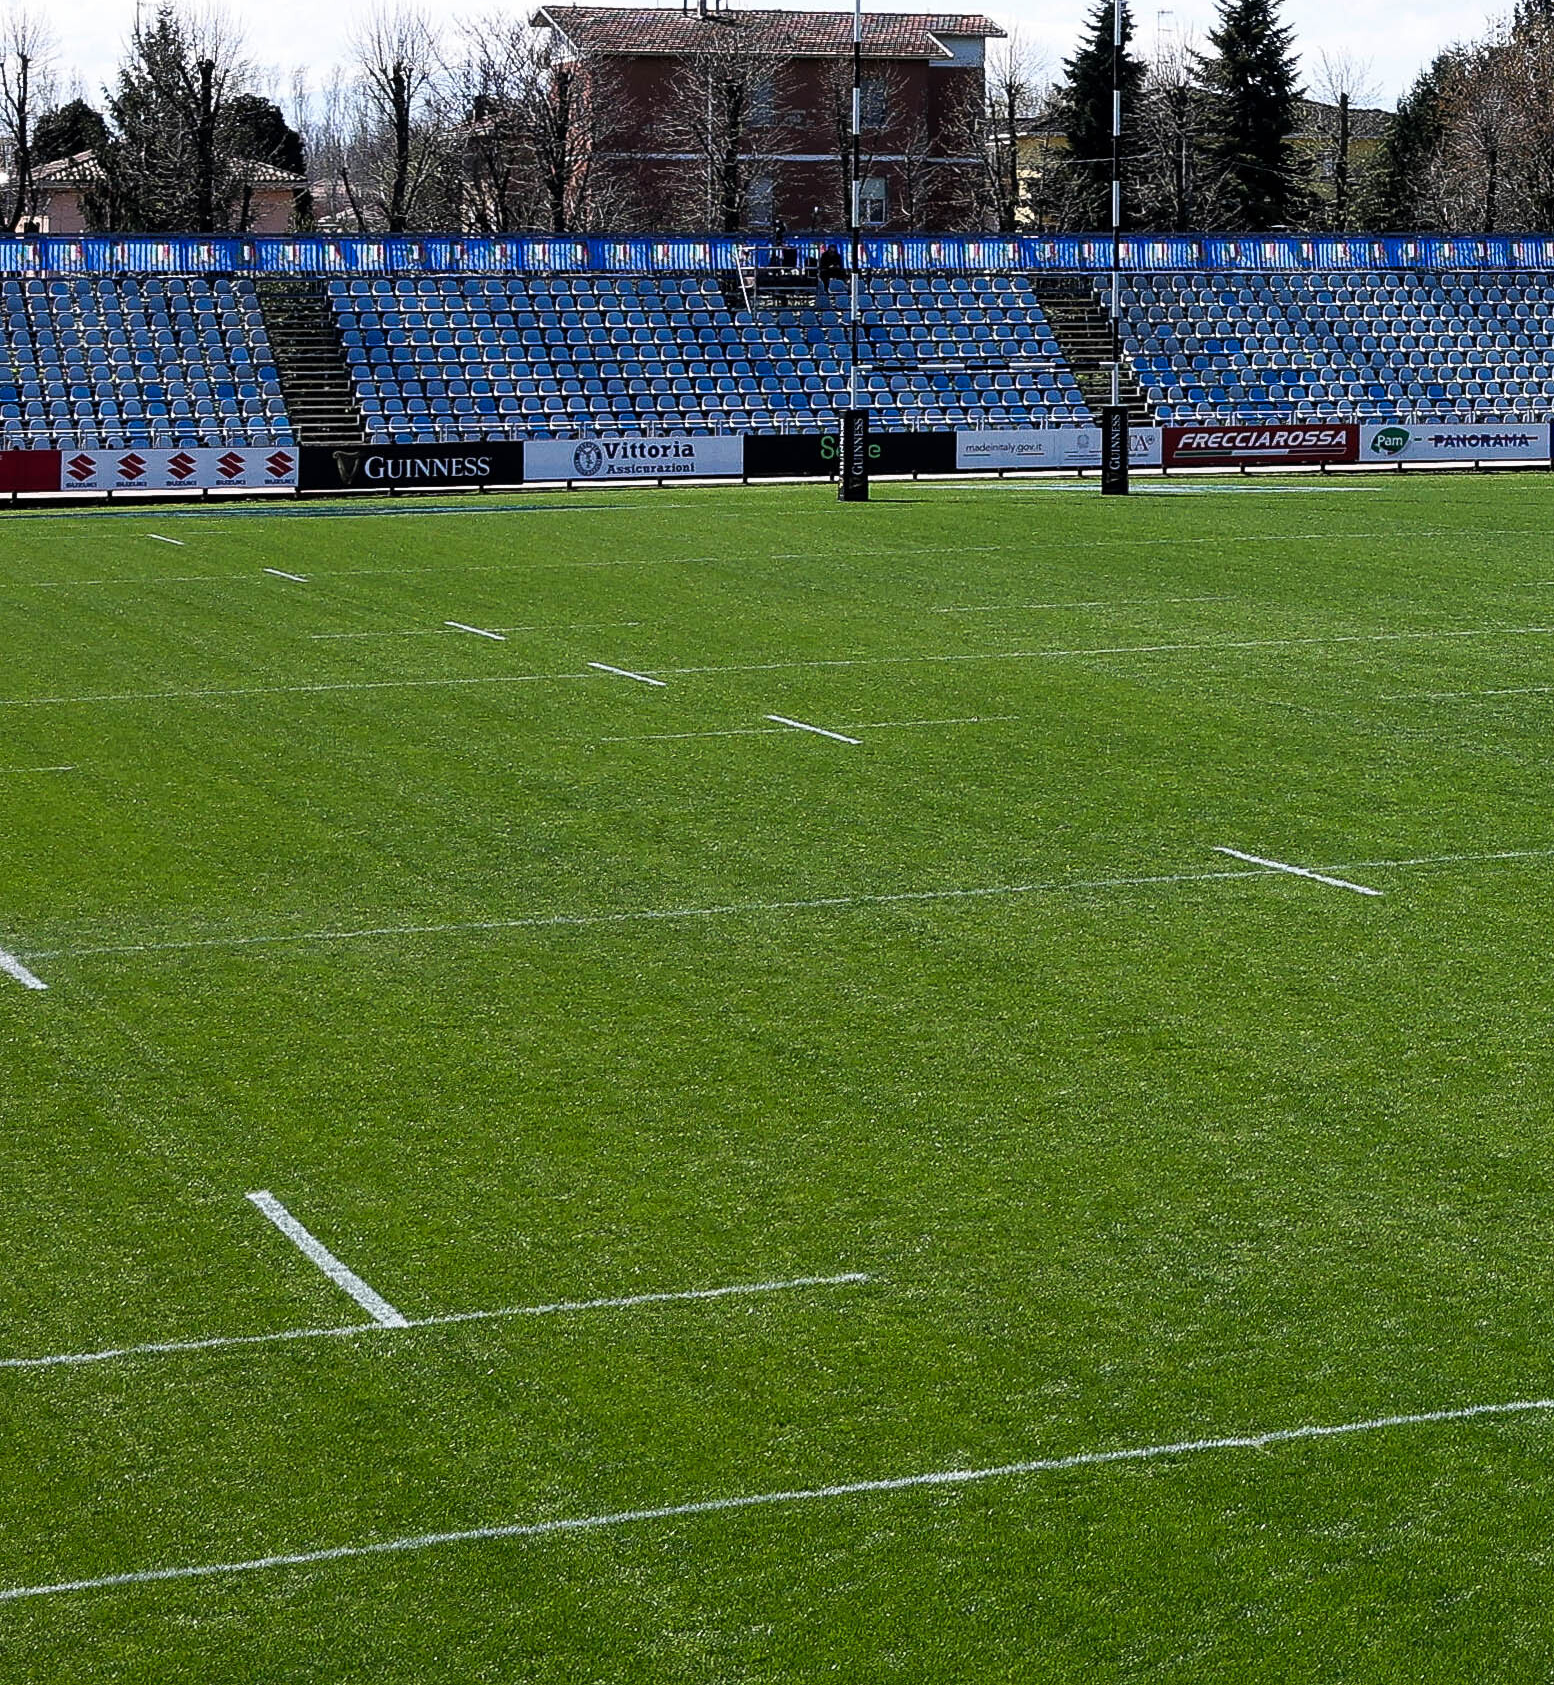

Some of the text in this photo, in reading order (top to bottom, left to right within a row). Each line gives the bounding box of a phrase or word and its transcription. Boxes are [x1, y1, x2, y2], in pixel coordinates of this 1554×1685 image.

[852, 418, 864, 475] GUINNESS
[1109, 414, 1120, 470] GUINNESS
[1177, 430, 1347, 449] FRECCIAROSSA
[1376, 434, 1403, 447] Pam
[1433, 434, 1530, 448] PANORAMA
[603, 441, 696, 459] Vittoria
[364, 454, 491, 479] GUINNESS
[606, 462, 695, 474] Assicurazioni
